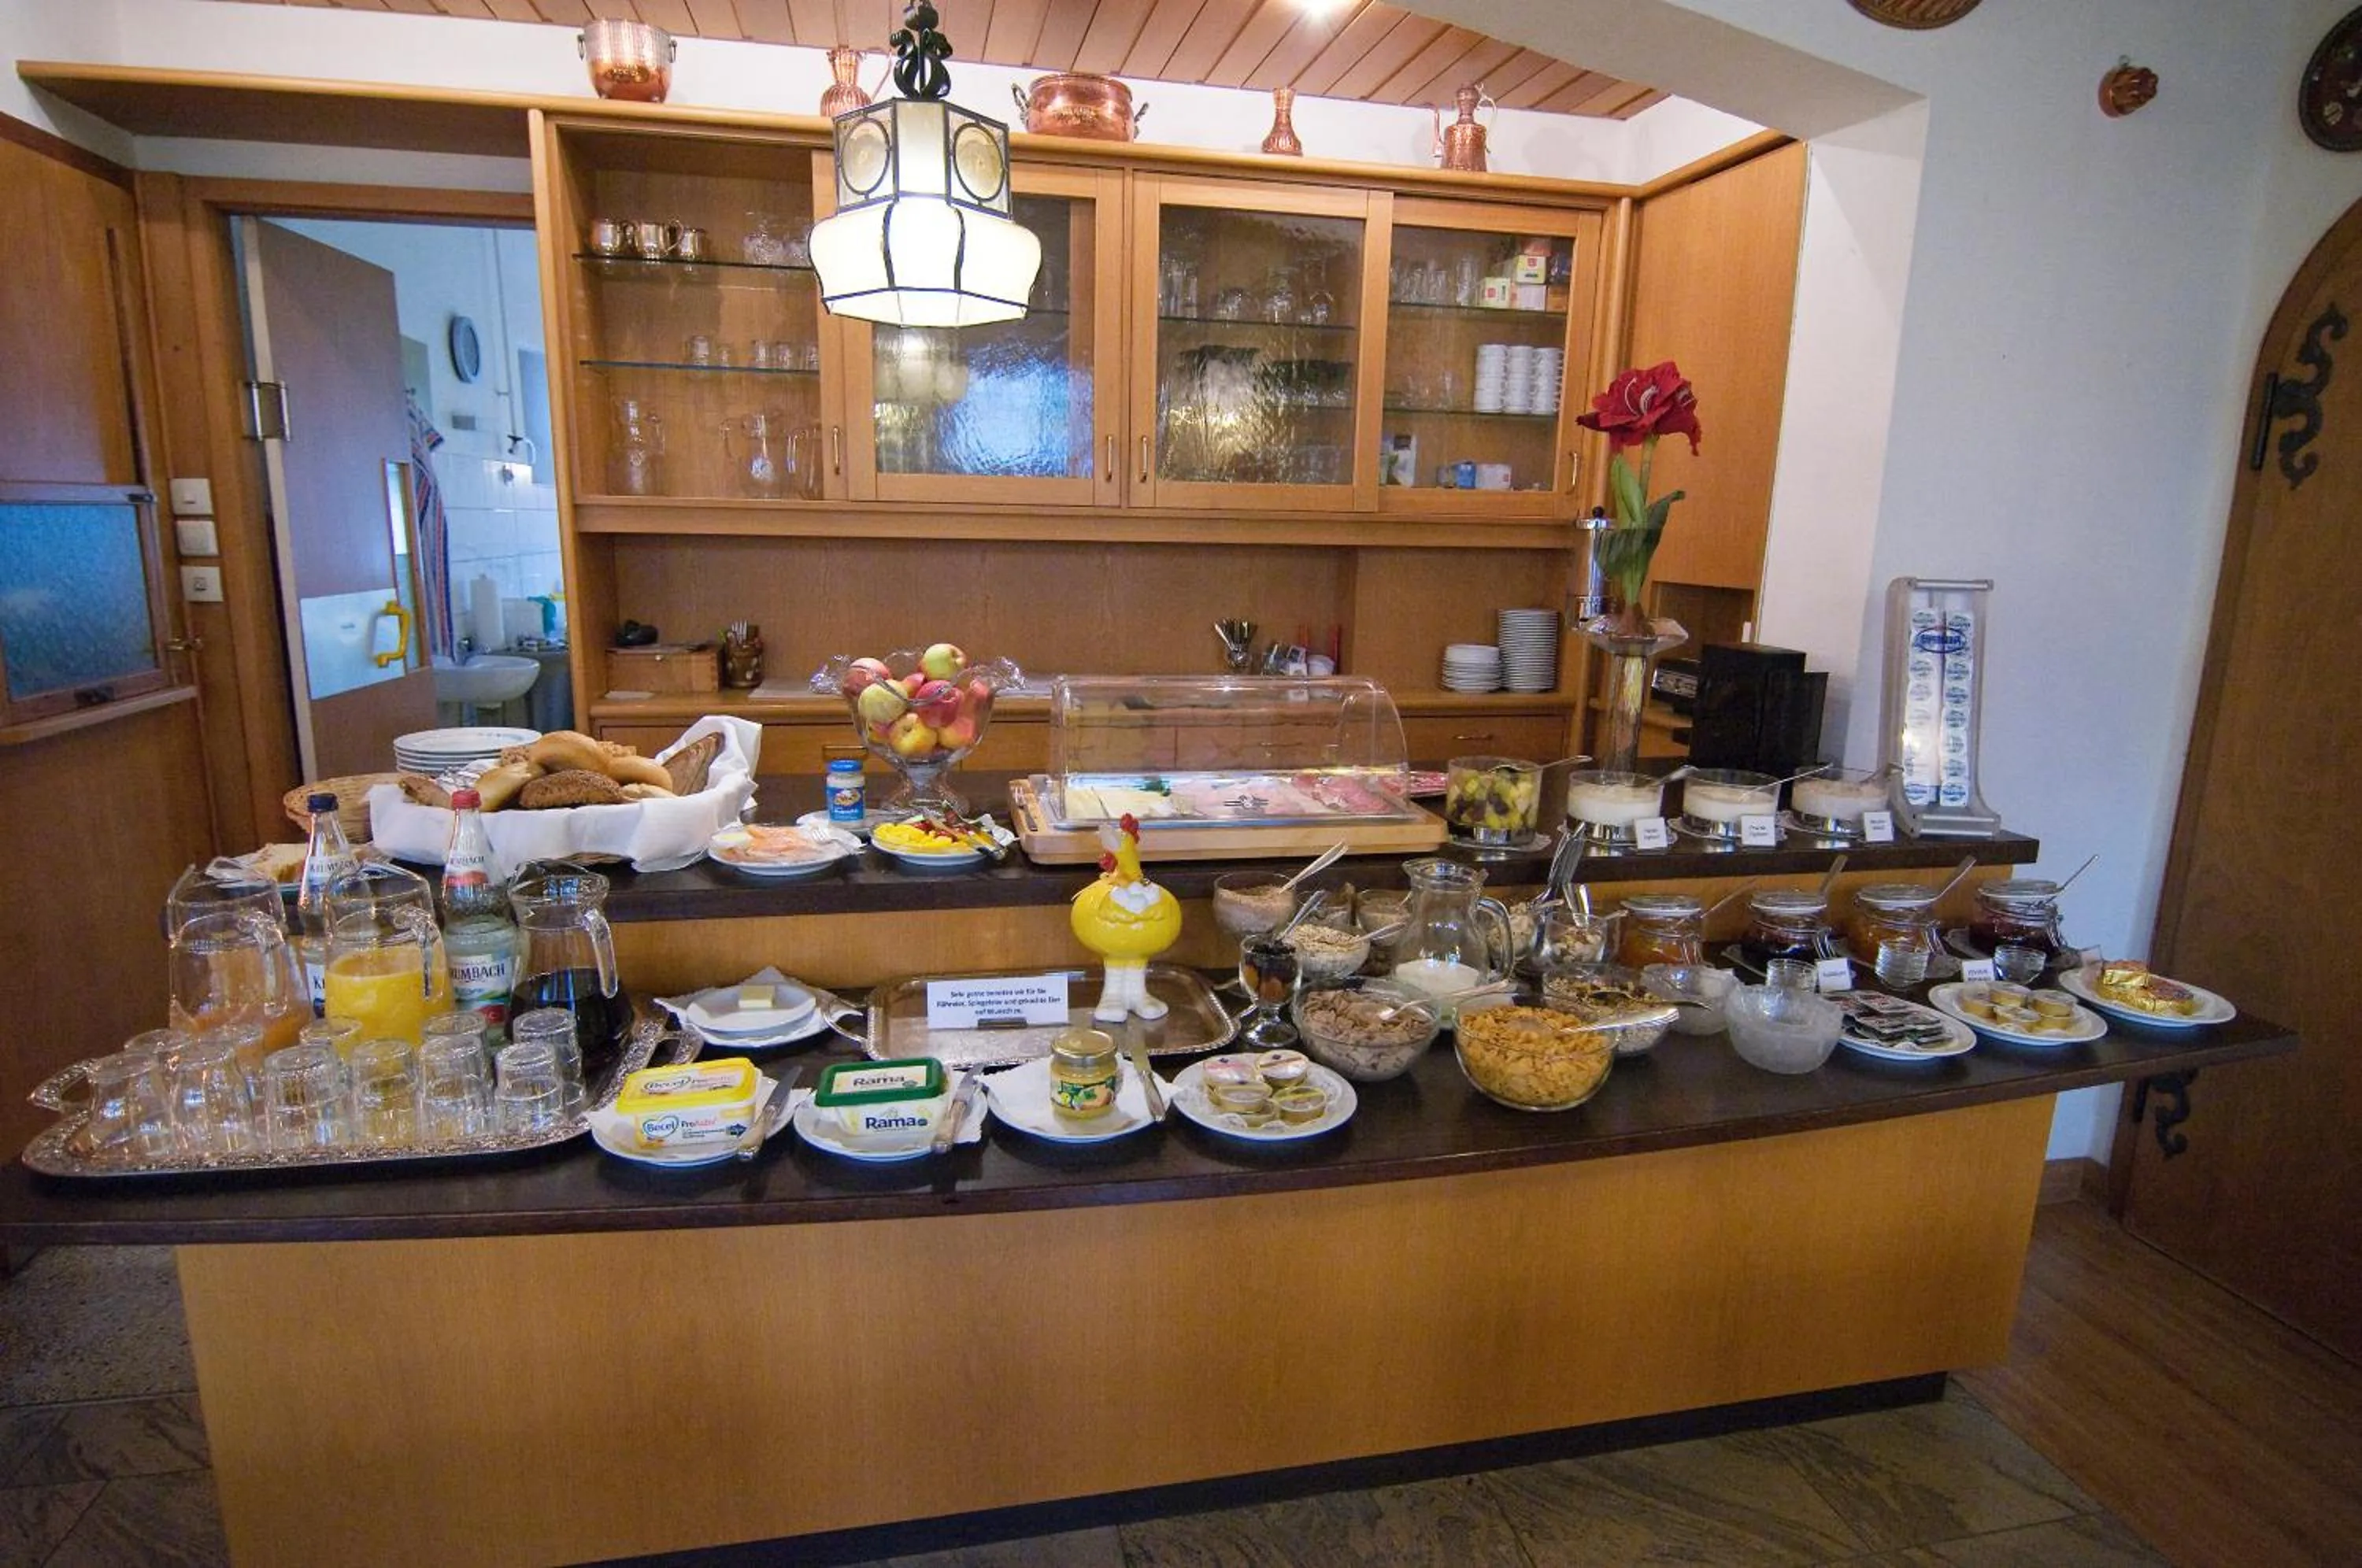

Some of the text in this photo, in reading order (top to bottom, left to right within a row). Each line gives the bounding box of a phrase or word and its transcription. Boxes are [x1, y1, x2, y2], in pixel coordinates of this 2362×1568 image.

[853, 1076, 905, 1086] Rama
[646, 1120, 676, 1132] Becel
[865, 1117, 916, 1130] Rama
